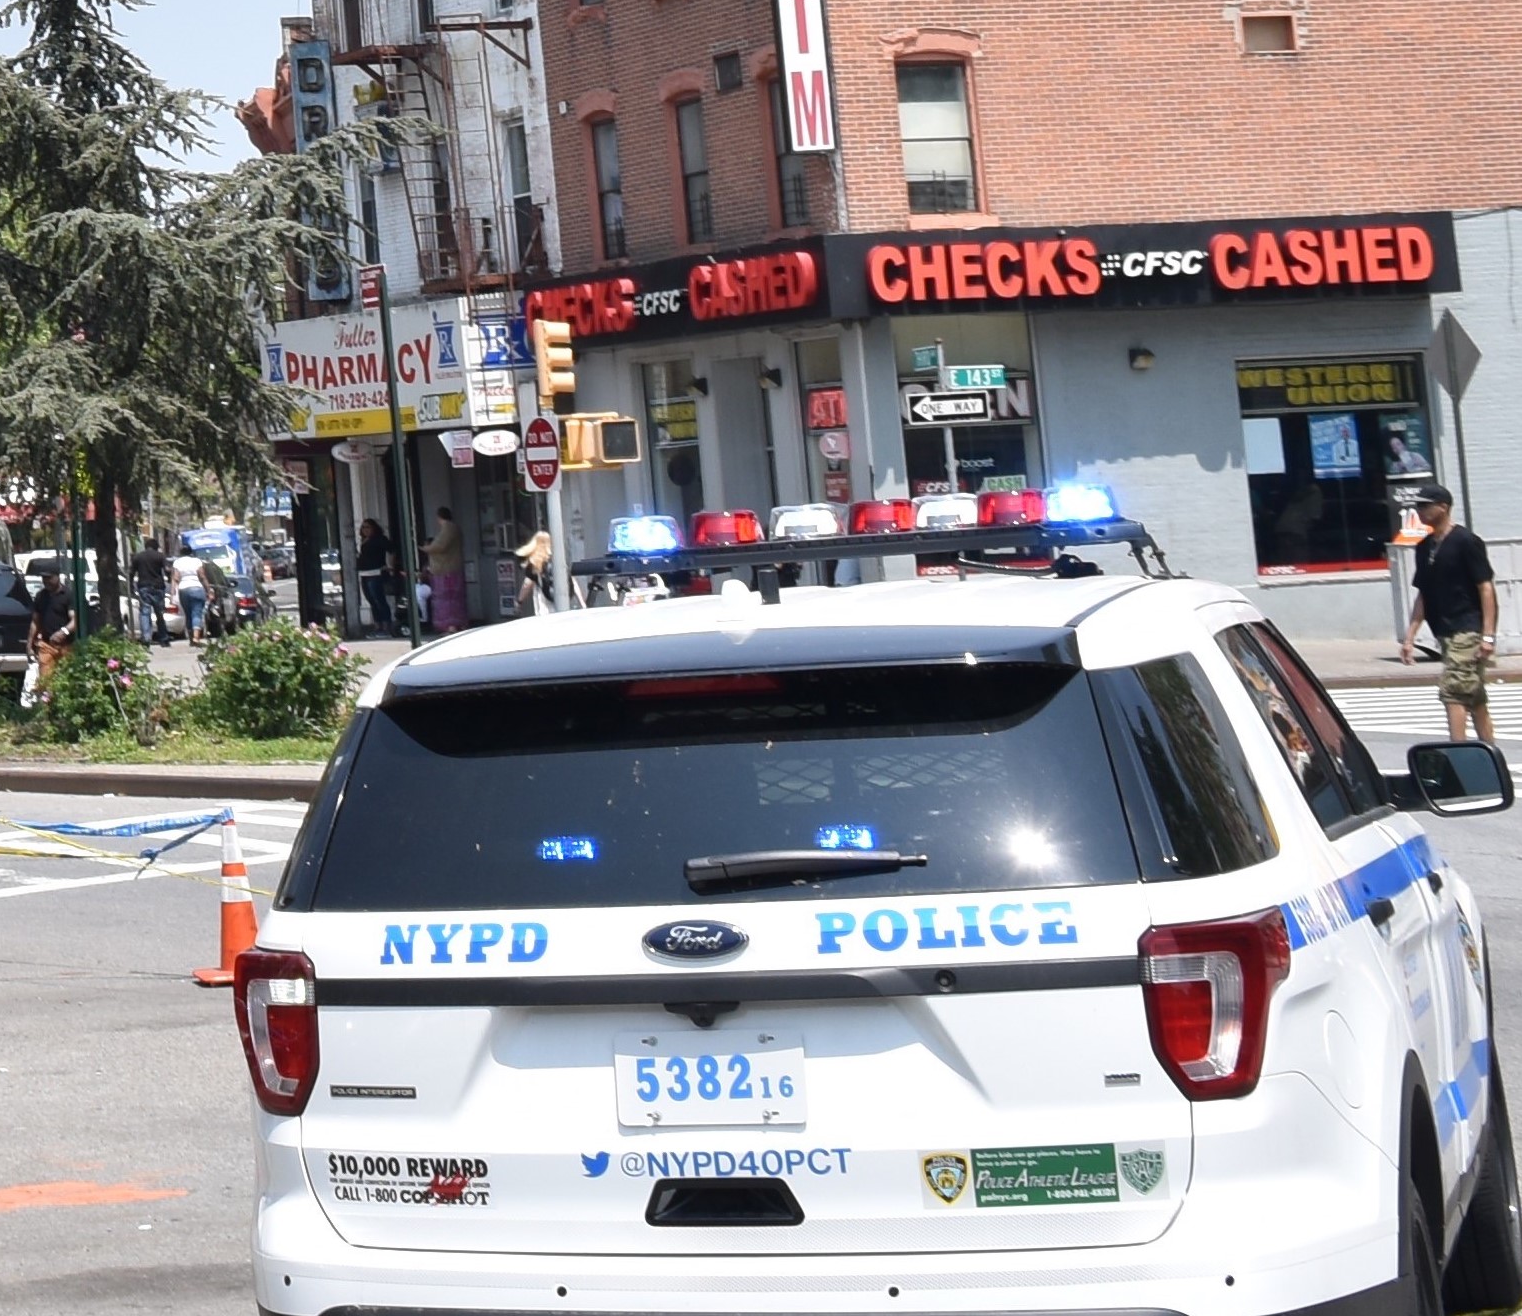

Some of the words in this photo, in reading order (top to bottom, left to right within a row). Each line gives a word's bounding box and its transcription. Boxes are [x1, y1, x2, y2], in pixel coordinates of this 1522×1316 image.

[867, 239, 1102, 304] CHECKS
[1122, 249, 1203, 277] CFSC
[1209, 225, 1435, 291] CASHED
[525, 278, 636, 338] CHECKS
[643, 289, 680, 316] CFSC
[689, 251, 818, 321] CASHED
[334, 321, 377, 350] Fuller
[949, 369, 958, 386] E
[966, 368, 991, 386] 143
[991, 368, 1003, 378] ST
[1239, 364, 1393, 388] WESTERN
[329, 390, 392, 410] 718-292-424
[1286, 383, 1396, 405] UNION
[921, 402, 943, 415] ONE
[954, 399, 980, 412] WAY
[527, 432, 538, 444] DO
[540, 431, 554, 443] NOT
[532, 464, 554, 476] ENTER
[925, 482, 951, 493] CFS
[665, 925, 723, 952] Ford
[815, 901, 1079, 955] POLICE
[380, 922, 549, 966] NYPD
[636, 1054, 754, 1103] 5382
[758, 1073, 794, 1100] 16
[332, 1087, 358, 1095] POLICE
[359, 1088, 414, 1096] INTERCEPTOR
[328, 1152, 401, 1179] $10,000
[406, 1157, 489, 1179] REWARD
[334, 1185, 362, 1201] CALL
[366, 1187, 398, 1203] 1-800
[399, 1190, 435, 1205] COP
[980, 1192, 1029, 1203] palnyc.org
